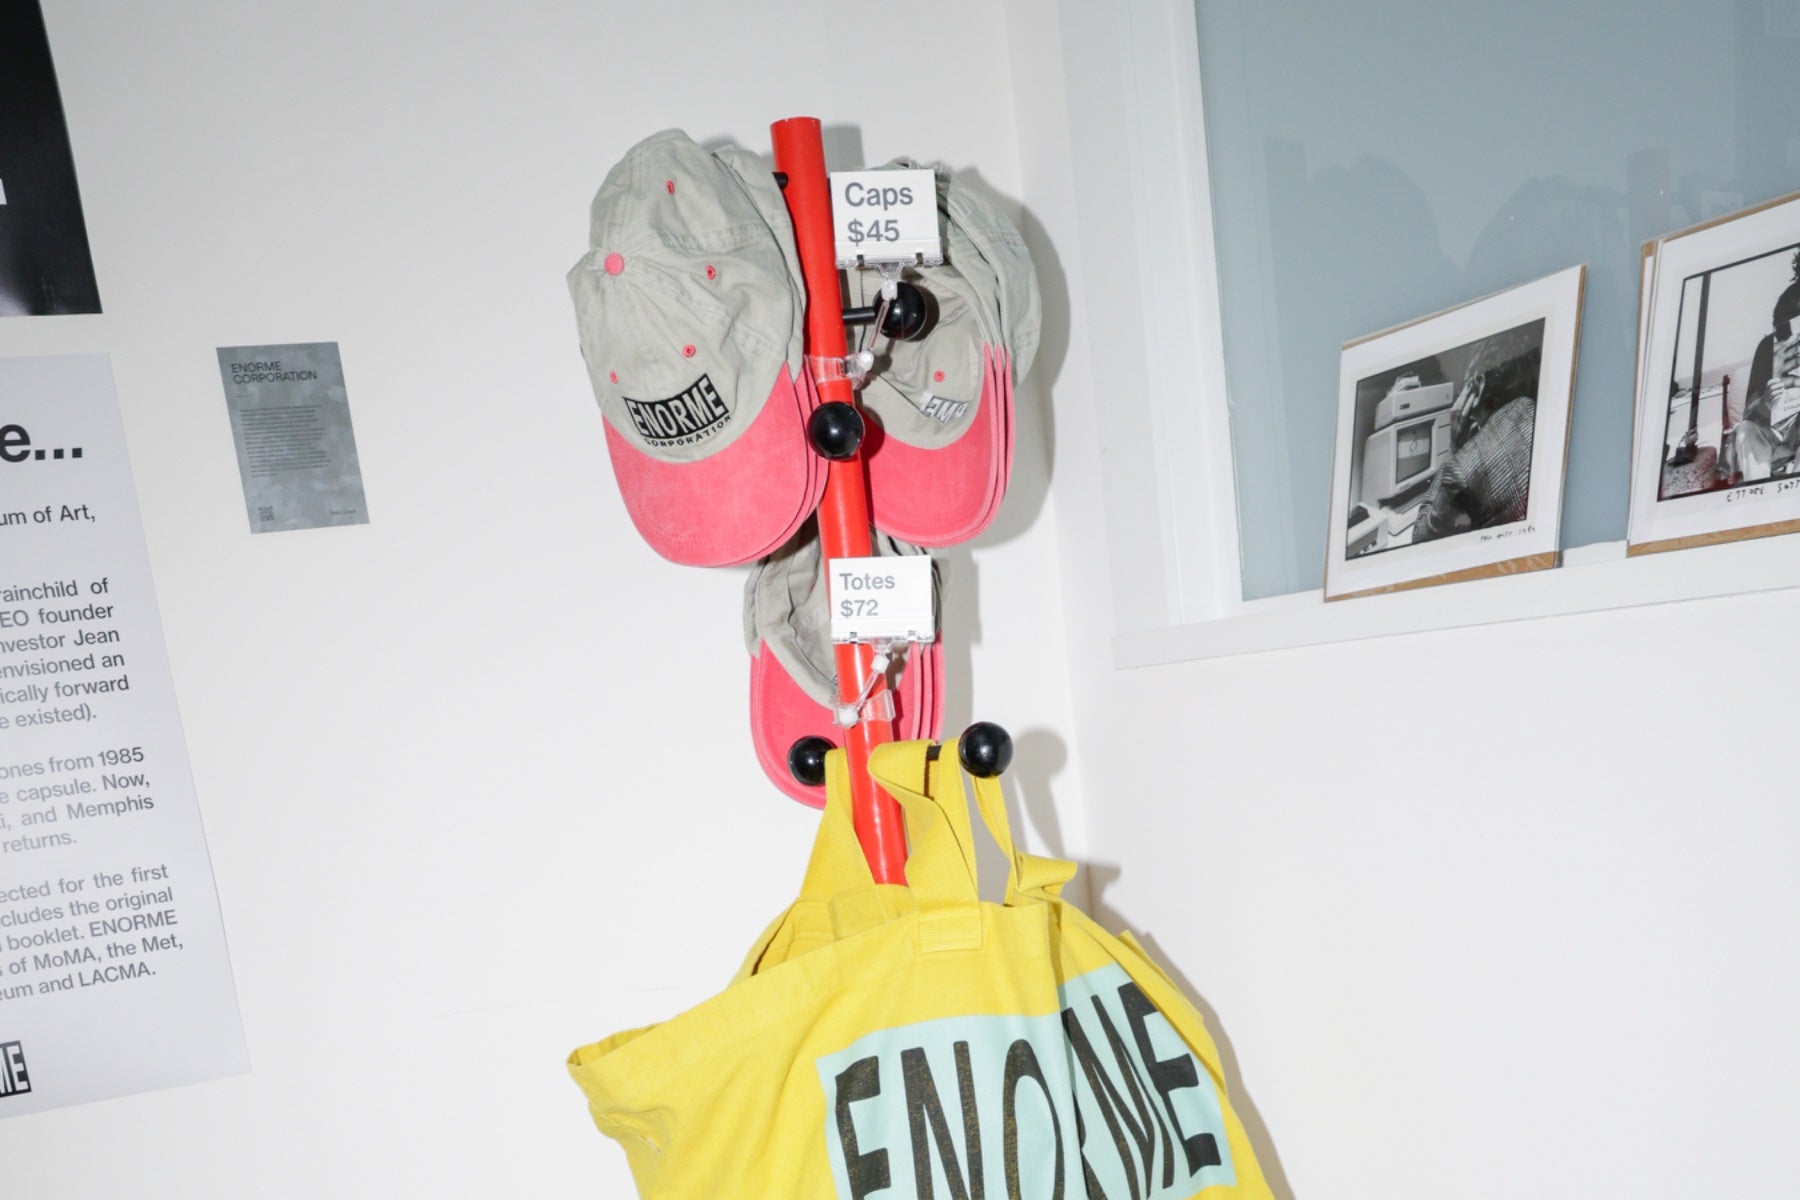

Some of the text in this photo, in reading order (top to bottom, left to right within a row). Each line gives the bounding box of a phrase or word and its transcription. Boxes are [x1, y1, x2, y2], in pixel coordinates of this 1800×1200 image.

[844, 182, 913, 211] Caps
[847, 218, 900, 247] $45
[231, 360, 282, 374] ENORME
[233, 370, 317, 385] CORPORATION
[624, 375, 727, 438] ENORME
[33, 506, 52, 523] of
[60, 504, 95, 523] Art,
[0, 577, 109, 602] ainchild of
[839, 573, 896, 590] Totes
[38, 603, 114, 624] founder
[840, 599, 879, 618] $72
[73, 629, 120, 646] Jean
[101, 653, 125, 668] an
[54, 674, 130, 698] forward
[15, 703, 97, 727] existed).
[48, 755, 94, 773] from
[97, 746, 144, 767] 1985
[16, 778, 96, 802] capsule.
[102, 773, 150, 791] Now,
[21, 806, 58, 826] and
[66, 794, 154, 817] Memphis
[2, 832, 77, 854] returns.
[58, 878, 85, 894] for
[93, 872, 124, 889] the
[131, 864, 169, 883] first
[68, 900, 100, 917] the
[105, 886, 174, 911] original
[6, 925, 85, 951] booklet.
[88, 909, 178, 938] ENORME
[8, 957, 27, 975] of
[33, 946, 102, 971] MoMA,
[106, 942, 137, 959] the
[141, 933, 184, 954] Met,
[38, 973, 74, 994] and
[78, 961, 157, 988] LACMA.
